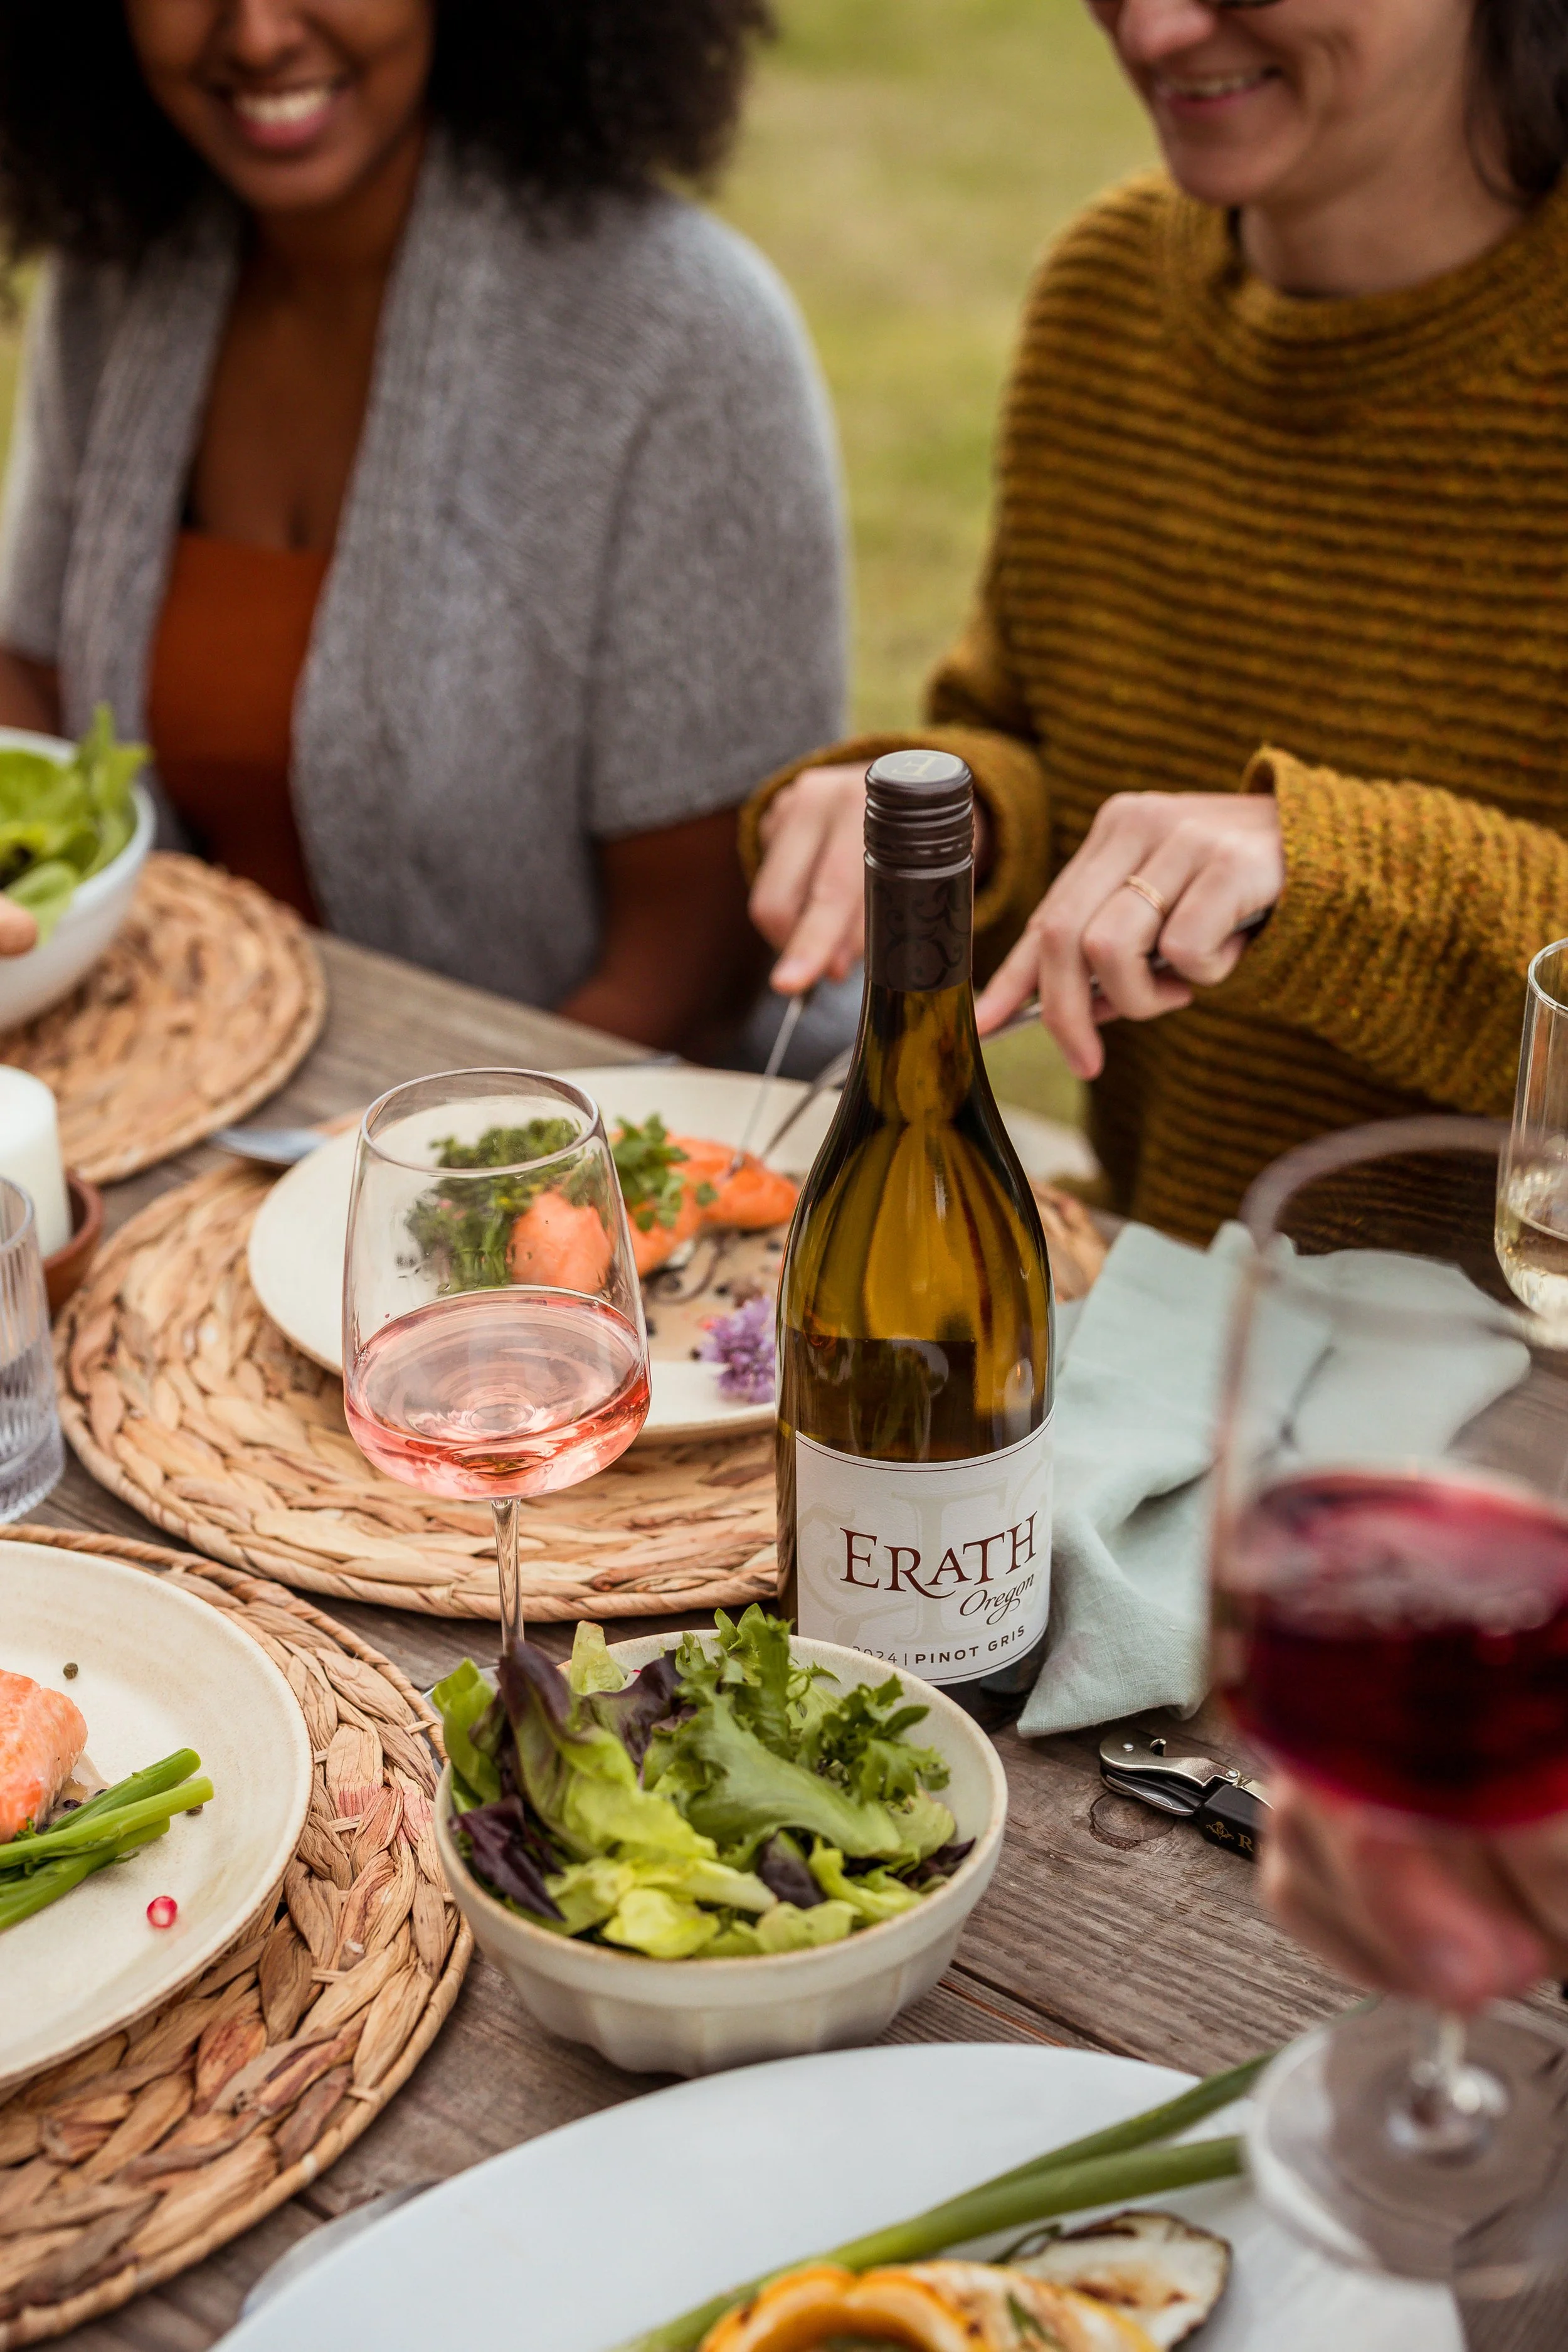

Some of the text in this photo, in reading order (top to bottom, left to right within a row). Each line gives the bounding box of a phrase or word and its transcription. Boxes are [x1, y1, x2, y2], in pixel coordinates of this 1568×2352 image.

[840, 1510, 1037, 1599] ERATH
[960, 1573, 1034, 1625] Oregon
[915, 1646, 979, 1664] PINOT
[988, 1626, 1025, 1652] GRIS
